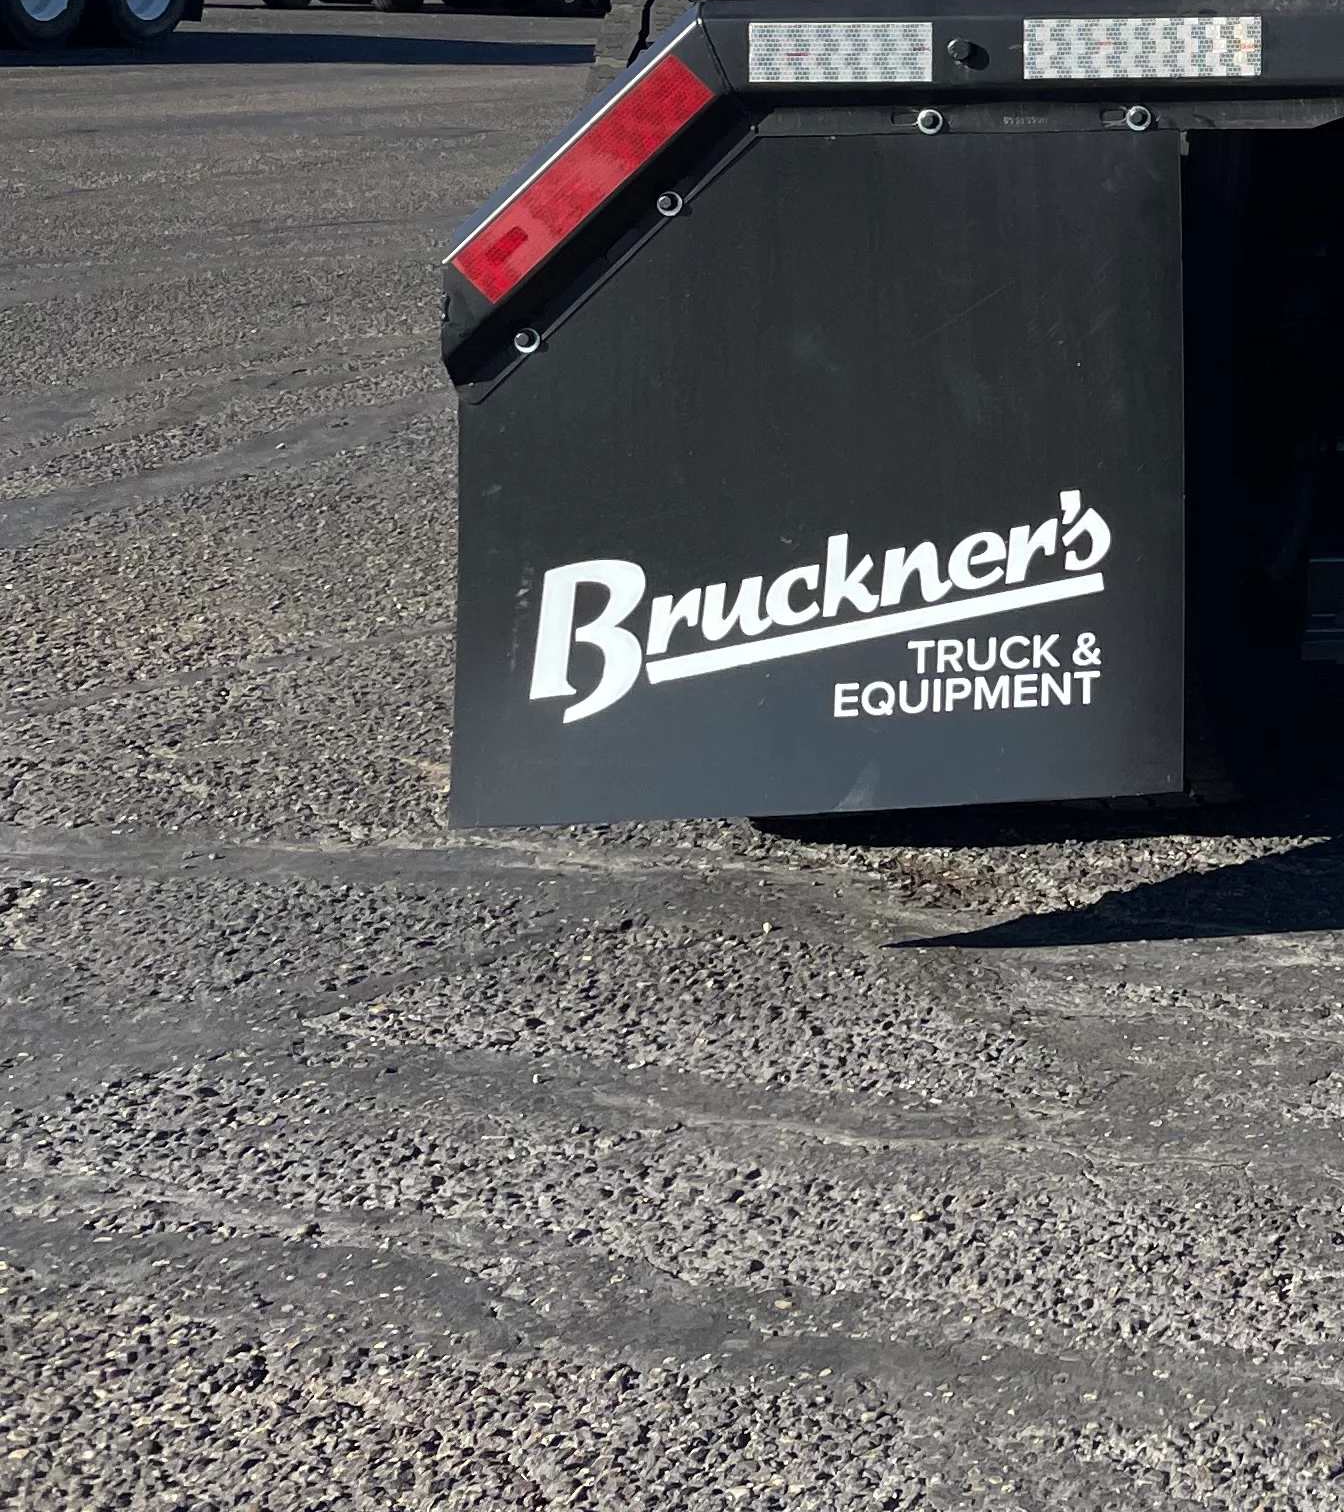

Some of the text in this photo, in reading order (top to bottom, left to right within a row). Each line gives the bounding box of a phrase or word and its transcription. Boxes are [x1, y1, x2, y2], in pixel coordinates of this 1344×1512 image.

[528, 489, 1111, 725] Bruckner's
[907, 632, 1102, 675] TRUCK &
[833, 670, 1101, 718] EQUIPMENT
